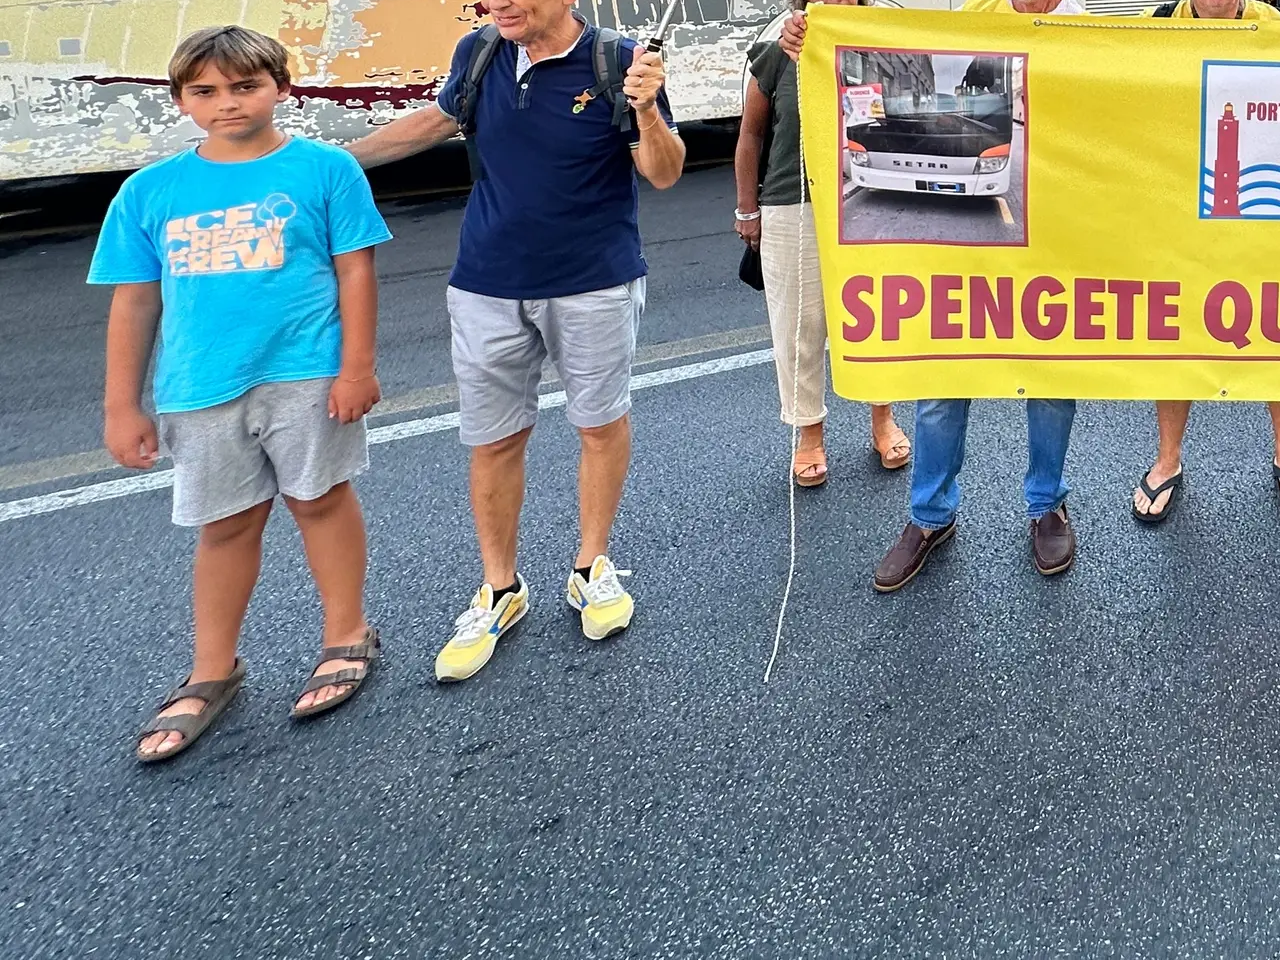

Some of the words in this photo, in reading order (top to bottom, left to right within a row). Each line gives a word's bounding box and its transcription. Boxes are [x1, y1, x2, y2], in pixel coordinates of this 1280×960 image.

[166, 203, 257, 233] ICE
[167, 226, 270, 258] CREAM
[169, 236, 285, 274] CREW
[841, 274, 1181, 342] SPENGETE
